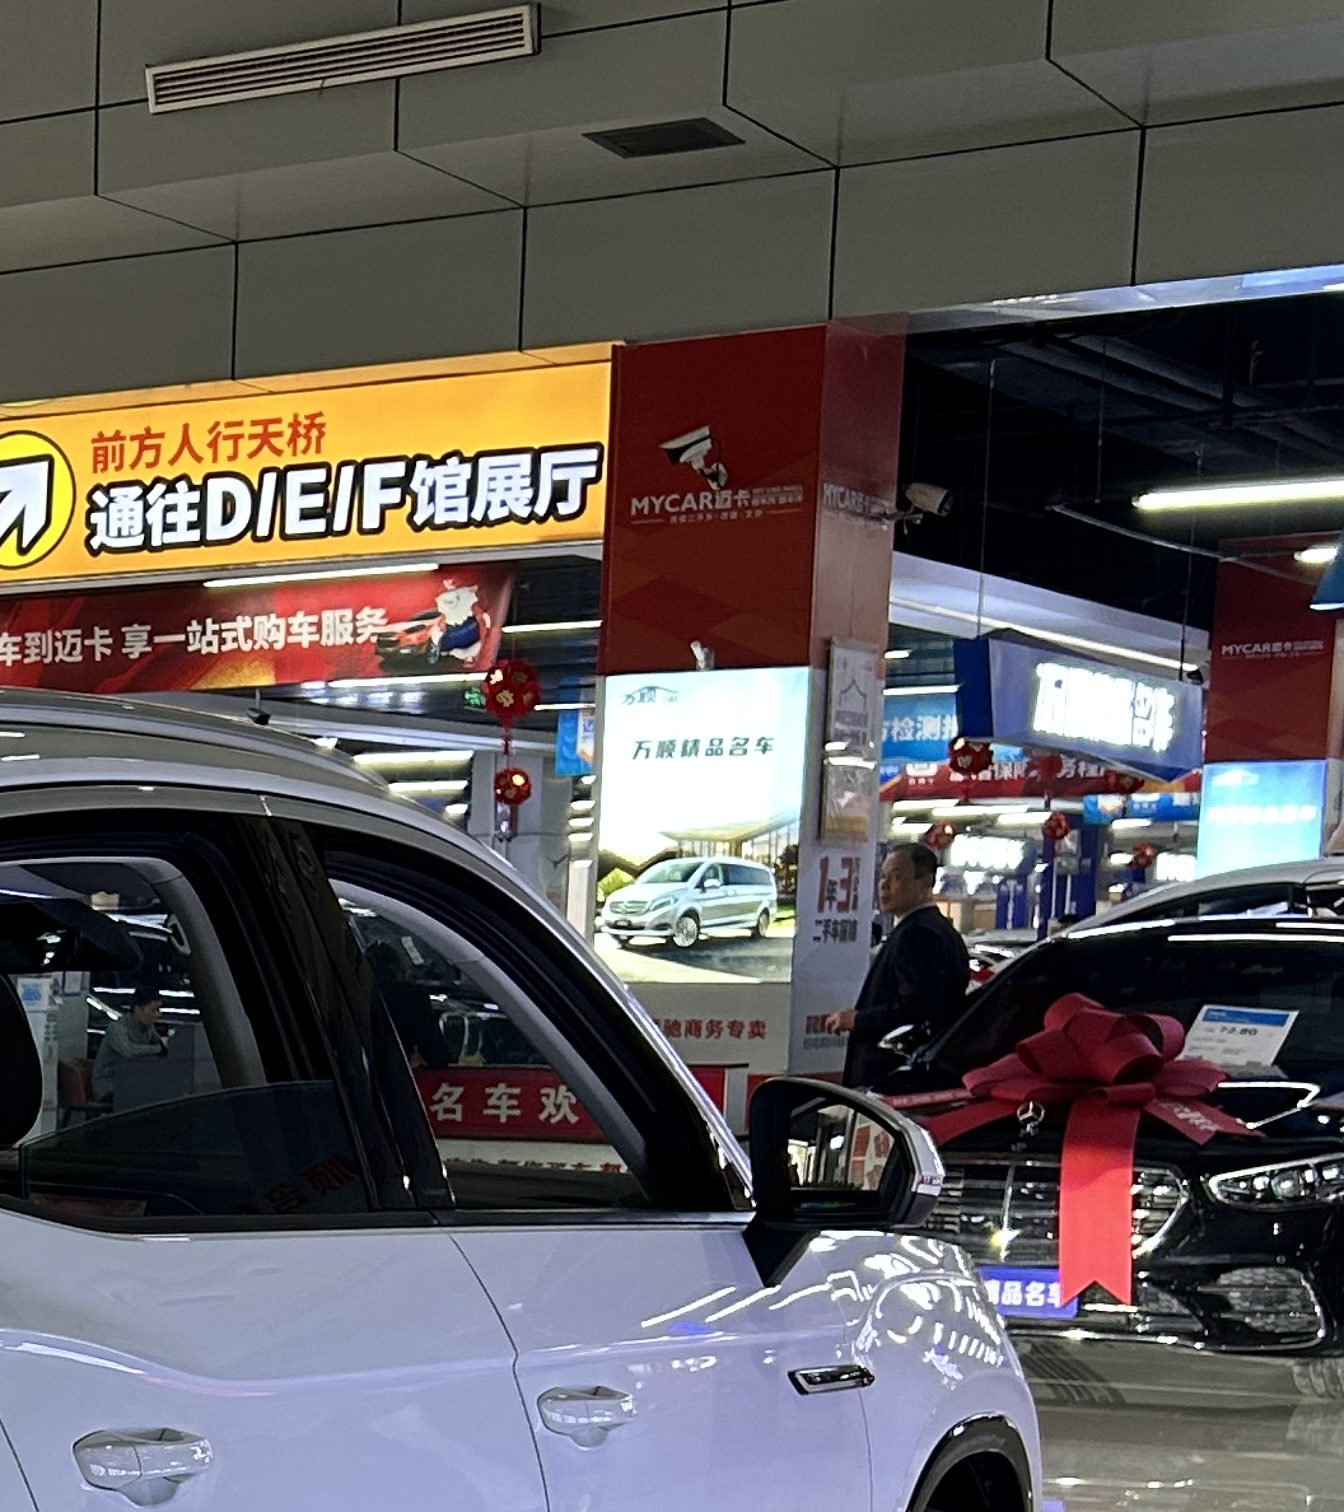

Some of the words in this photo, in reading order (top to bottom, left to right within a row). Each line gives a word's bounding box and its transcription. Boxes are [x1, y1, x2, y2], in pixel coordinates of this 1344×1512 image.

[90, 411, 327, 475] 前方人行天桥
[89, 447, 602, 551] 通往D/E/F馆展厅
[120, 606, 389, 660] 享一站式购车服务
[632, 736, 775, 761] 万顺精品名车
[655, 1019, 767, 1040] 驰商务专卖
[429, 1082, 581, 1126] 名车欢
